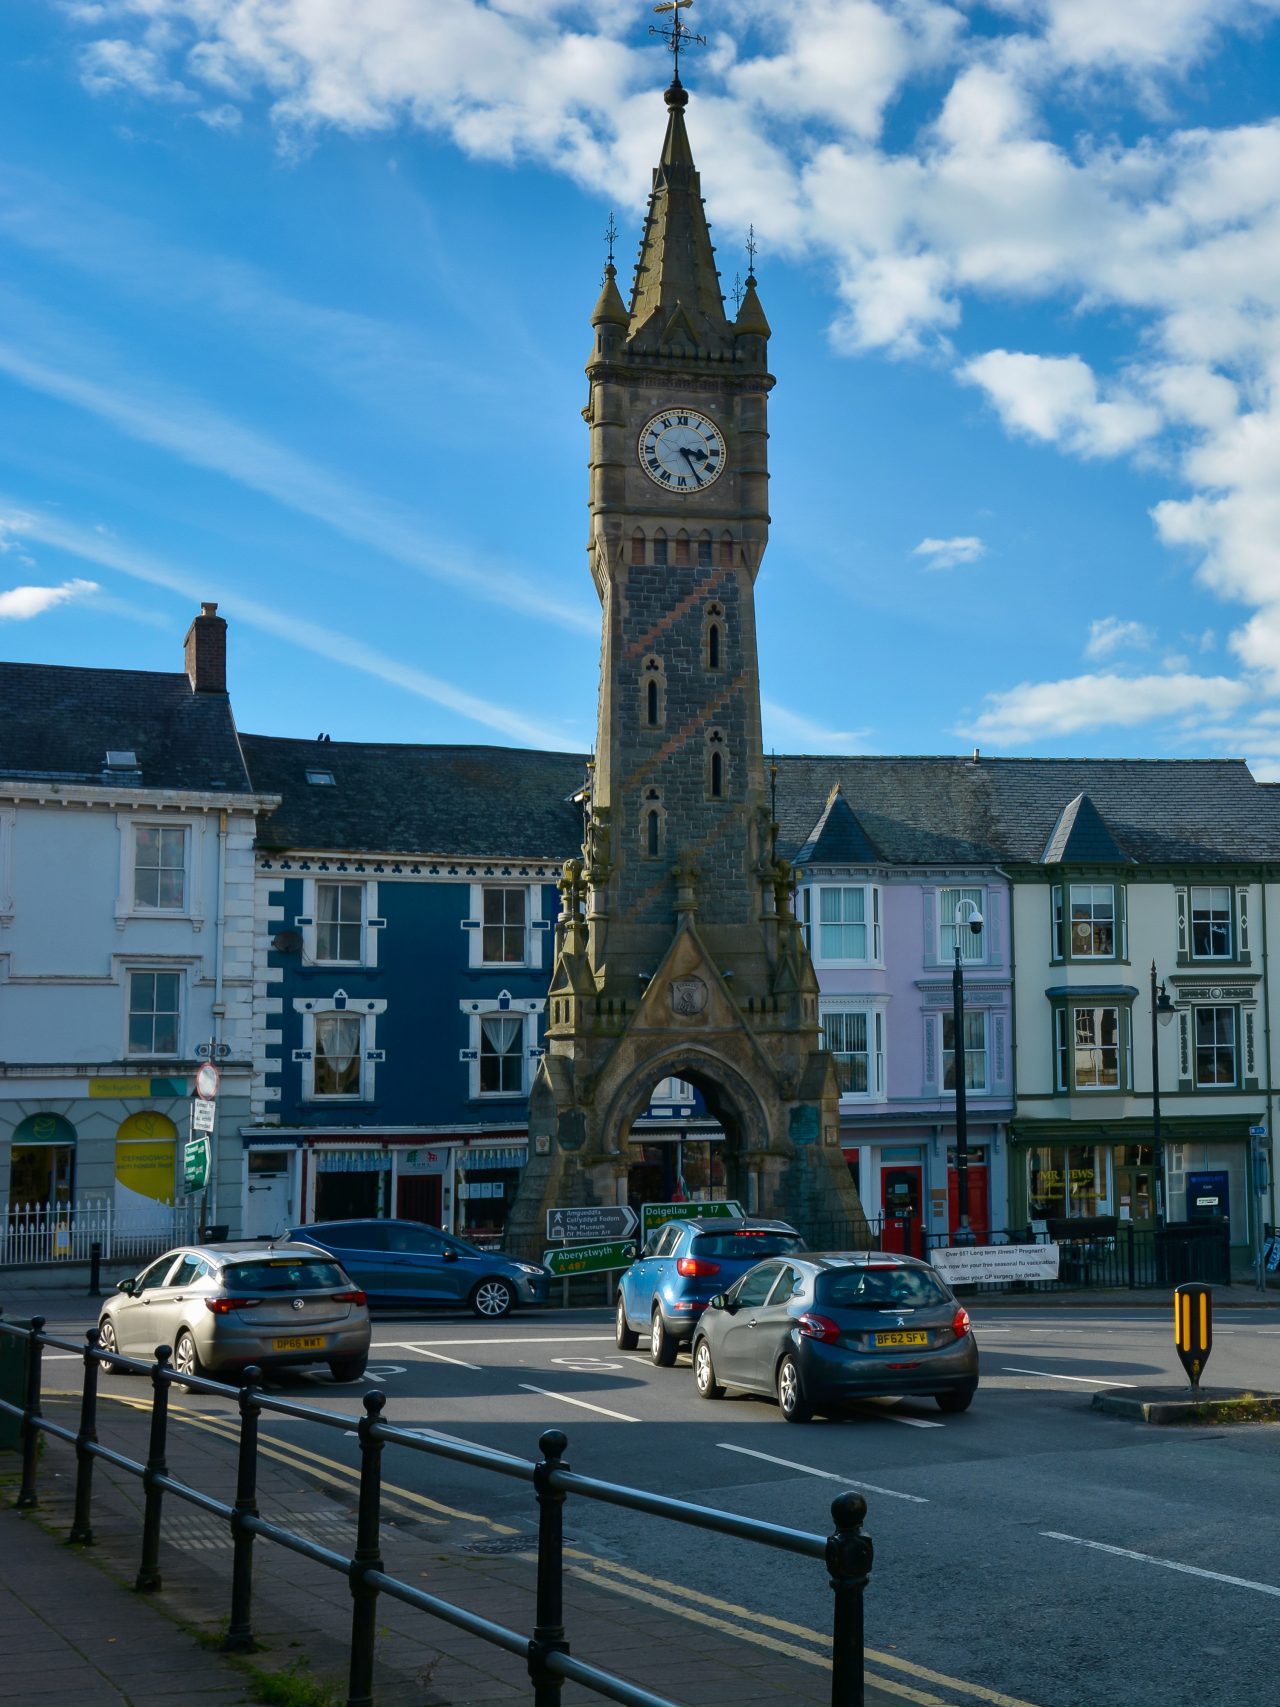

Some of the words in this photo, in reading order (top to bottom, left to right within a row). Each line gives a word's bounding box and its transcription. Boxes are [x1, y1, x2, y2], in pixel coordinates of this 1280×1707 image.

[660, 418, 672, 429] XI
[676, 416, 688, 426] XII
[649, 430, 660, 438] X
[645, 1206, 687, 1216] Dolgellau
[710, 1205, 719, 1214] 17
[558, 1246, 613, 1260] Aberystwyth
[568, 1261, 587, 1271] 487
[277, 1338, 302, 1349] DP66
[876, 1333, 904, 1345] BF62
